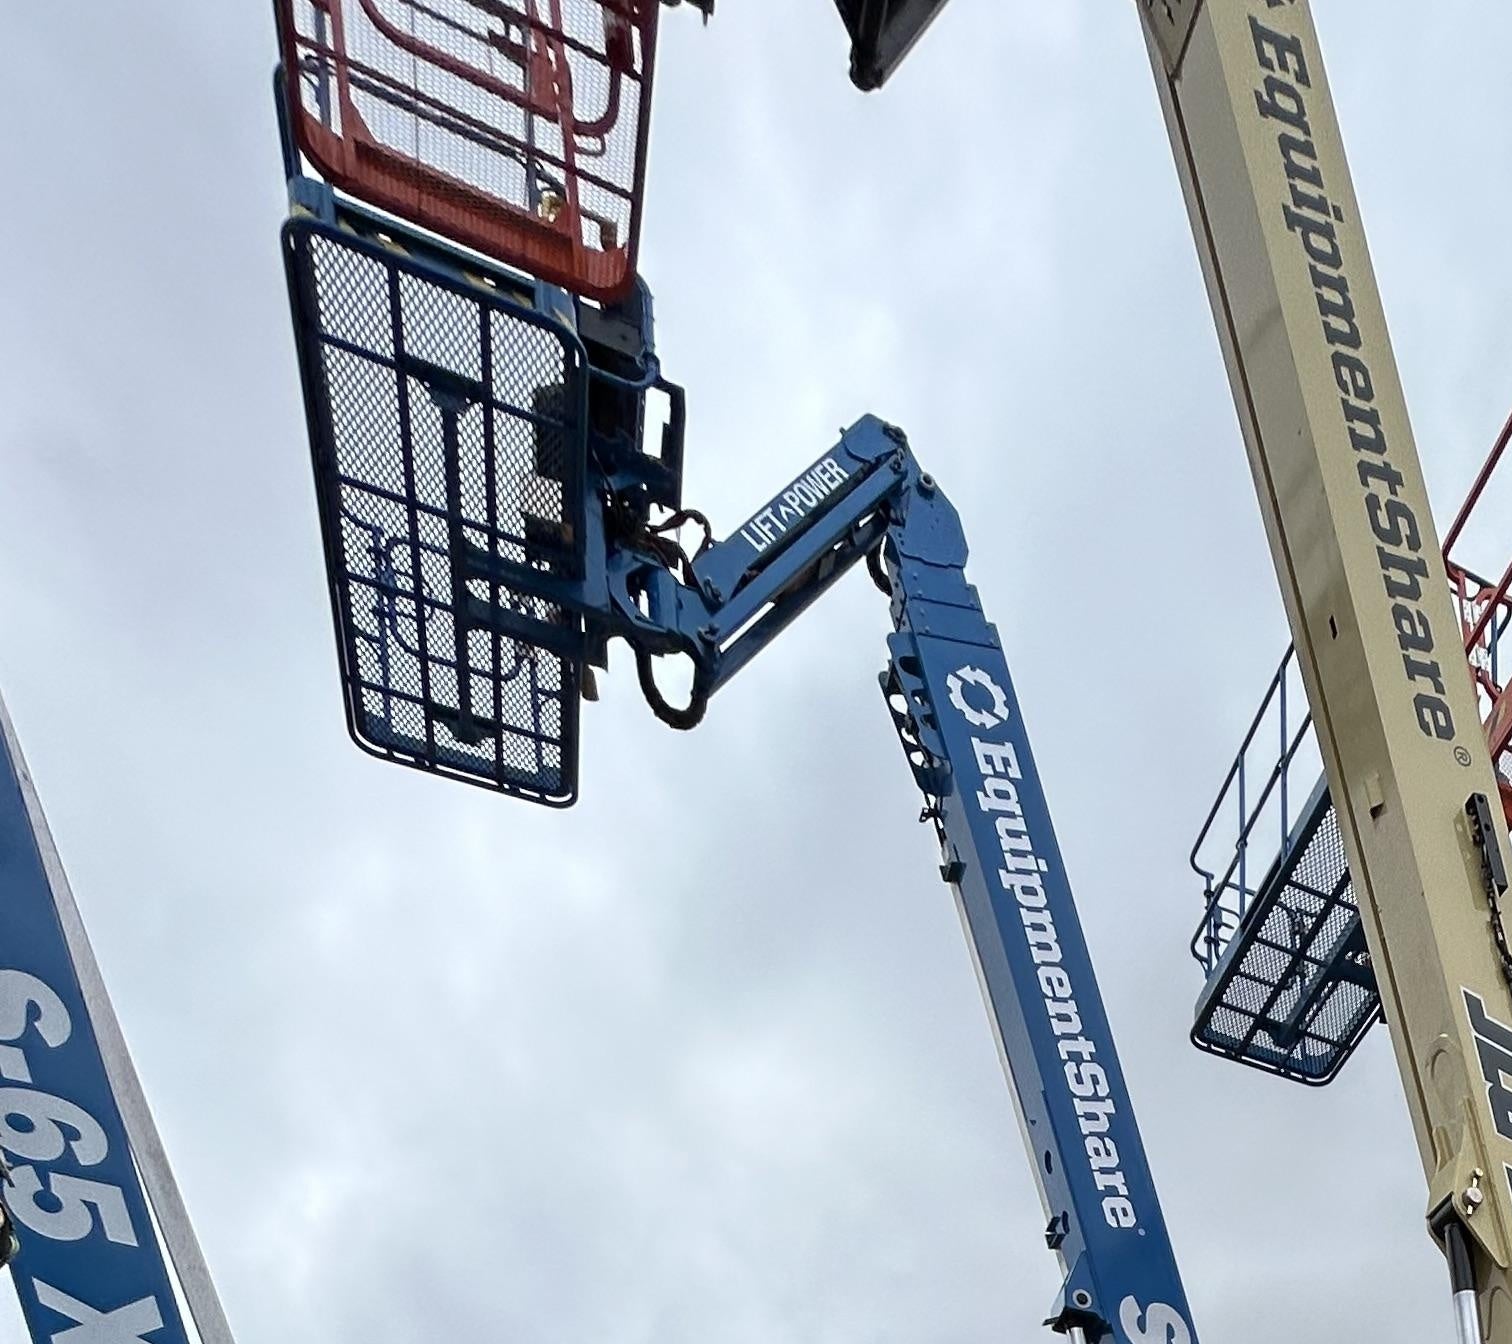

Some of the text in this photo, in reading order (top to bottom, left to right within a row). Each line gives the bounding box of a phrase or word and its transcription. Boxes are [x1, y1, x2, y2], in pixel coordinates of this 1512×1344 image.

[740, 457, 850, 553] LIFT POWER
[1249, 15, 1456, 742] EquipmentShare
[970, 736, 1139, 1231] EquipmentShare
